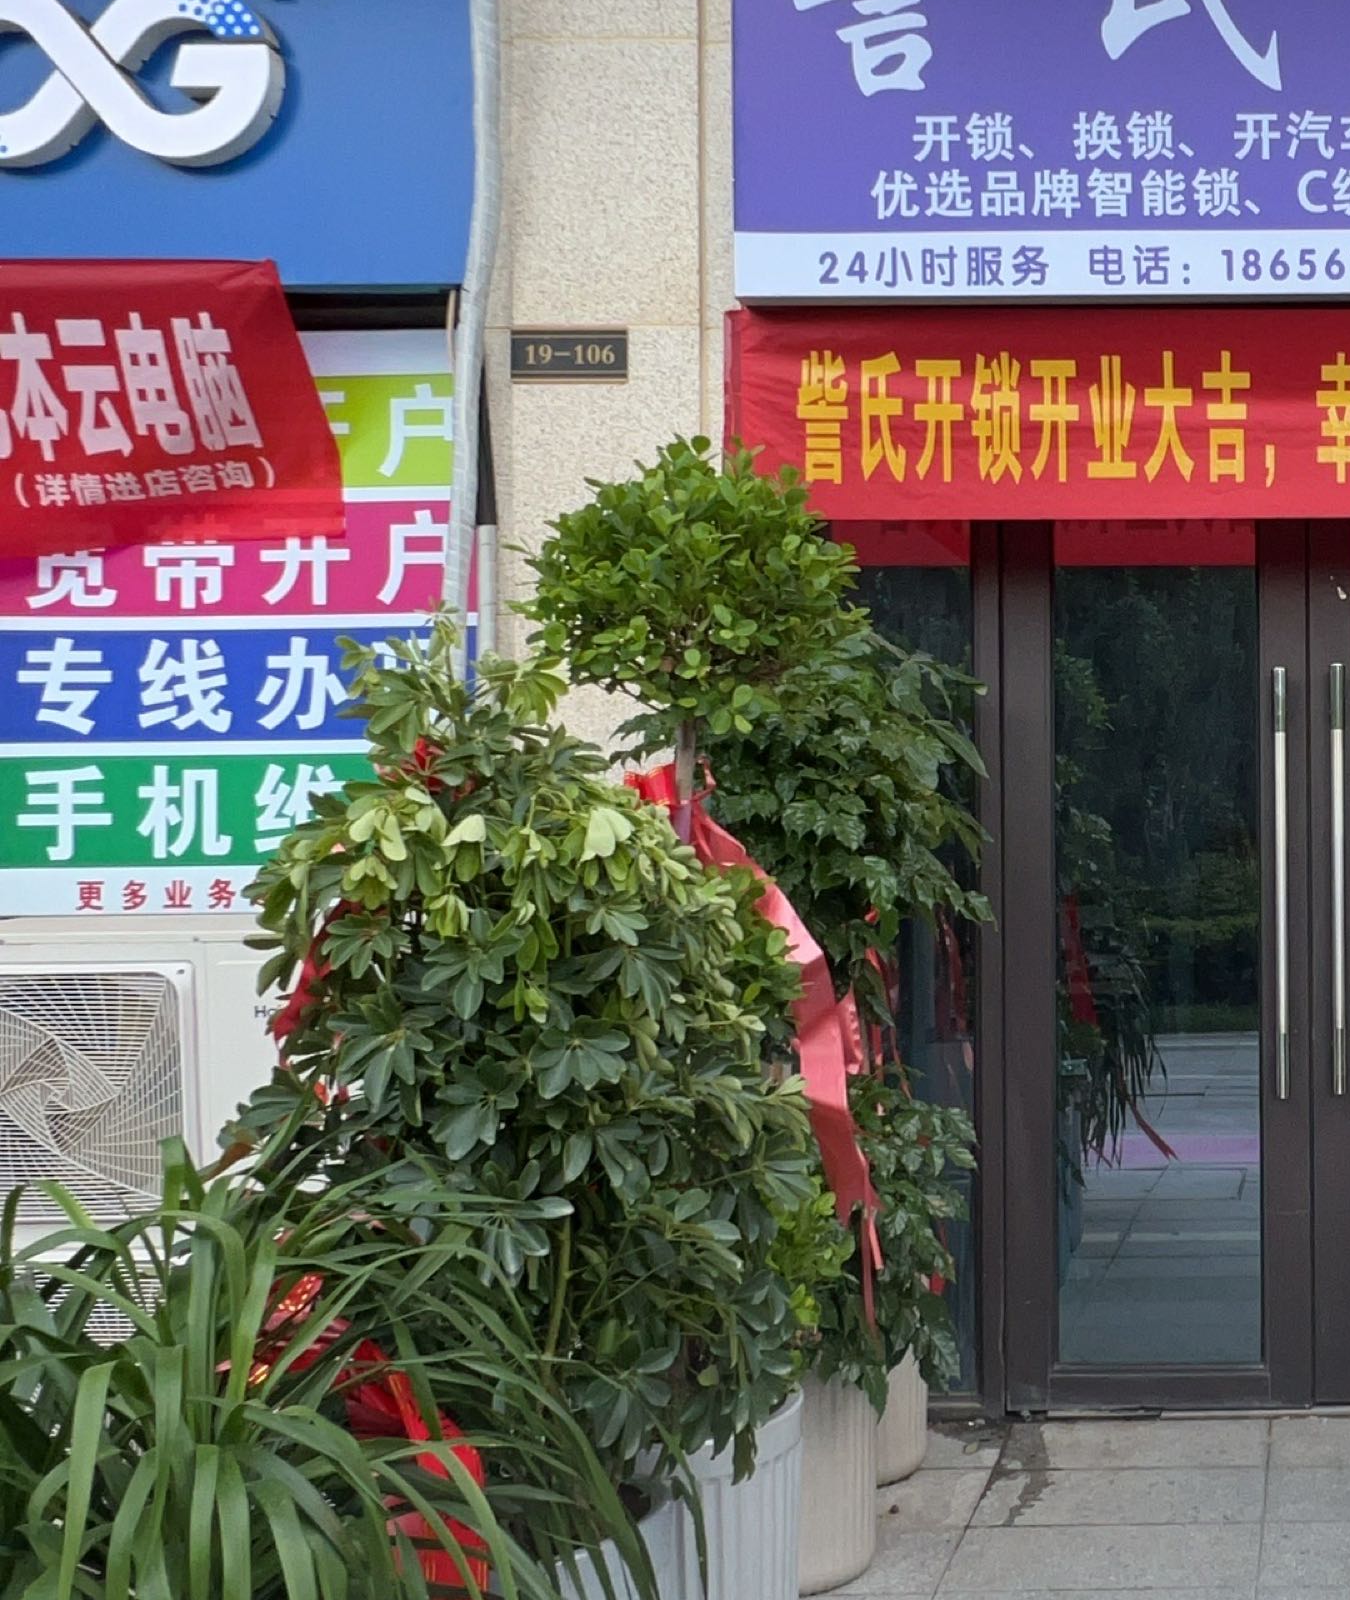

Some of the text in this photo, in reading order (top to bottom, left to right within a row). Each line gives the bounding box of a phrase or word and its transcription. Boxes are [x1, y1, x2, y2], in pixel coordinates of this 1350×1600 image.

[818, 246, 1050, 287] 24小时服务
[525, 343, 616, 366] 19-106
[0, 312, 264, 462] 本云电脑
[16, 636, 438, 735] 专线办
[76, 879, 268, 910] 更多业务
